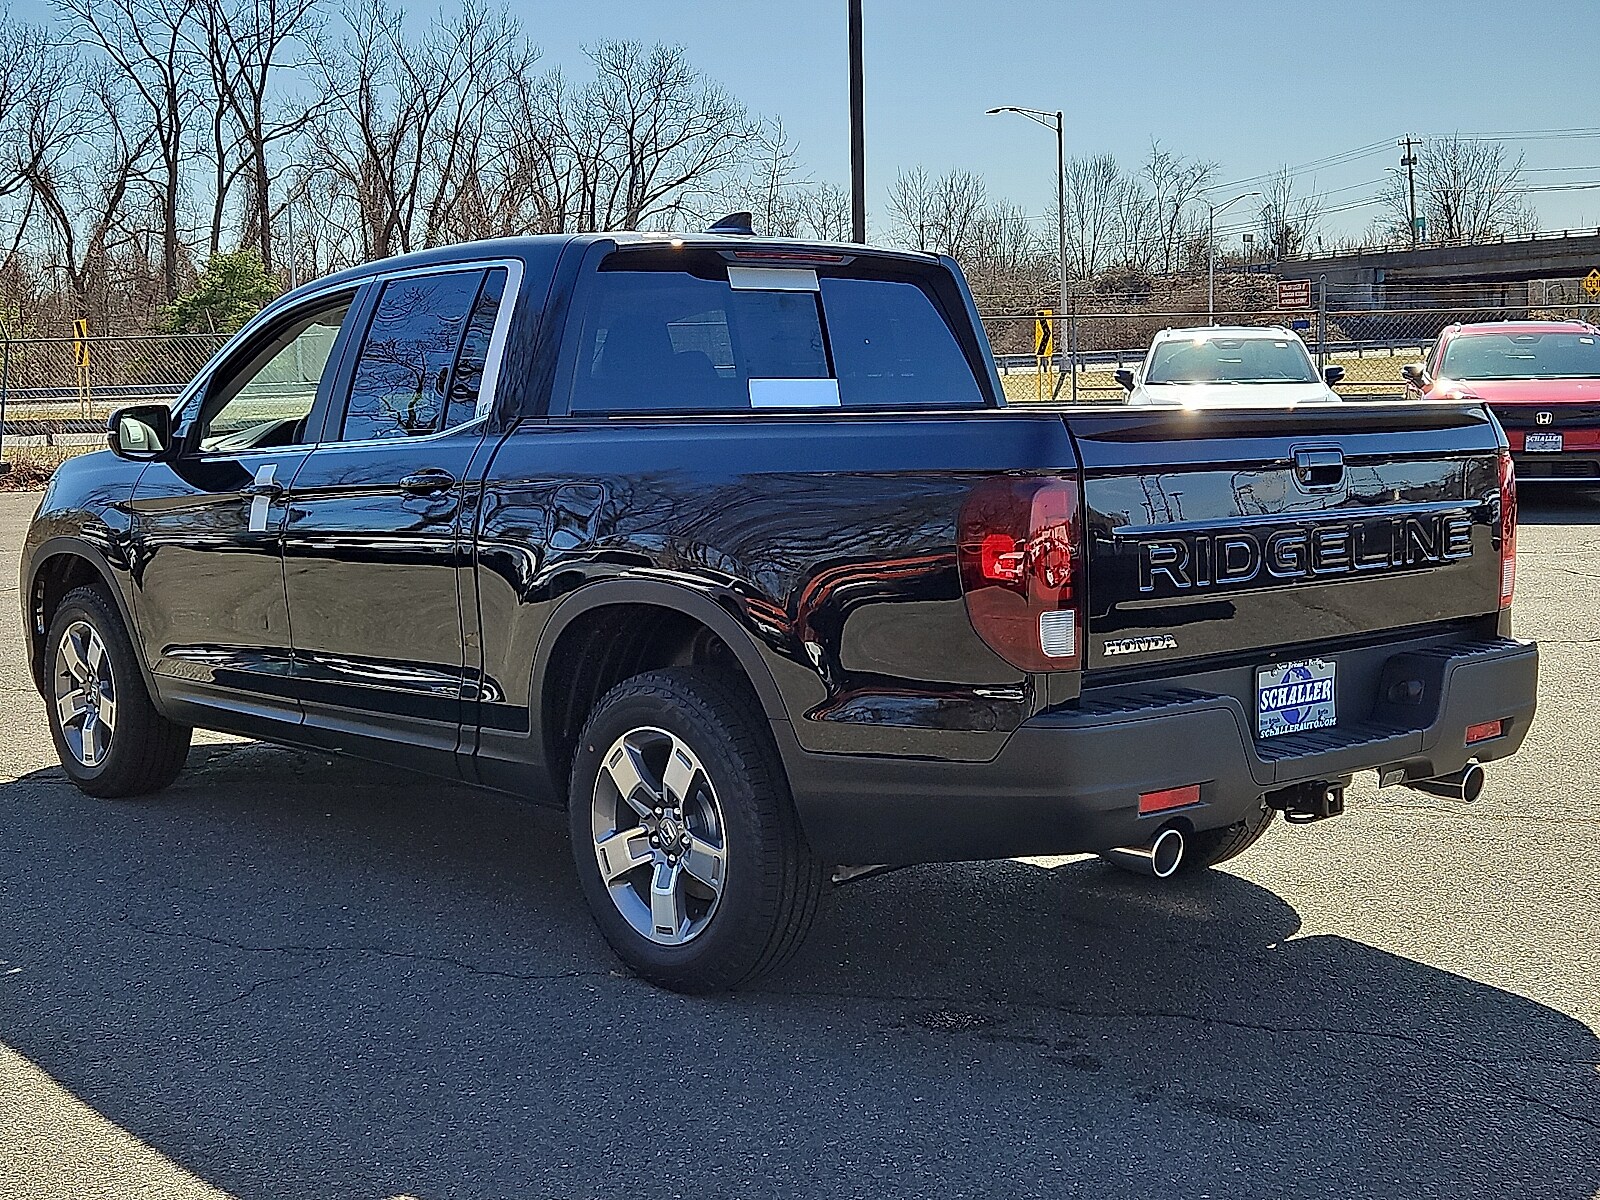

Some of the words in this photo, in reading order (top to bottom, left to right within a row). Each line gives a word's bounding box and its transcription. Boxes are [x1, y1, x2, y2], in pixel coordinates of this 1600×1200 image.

[1137, 508, 1474, 592] RIDGELINE
[1103, 635, 1178, 656] HONDA
[1260, 679, 1332, 711] SCHALLER
